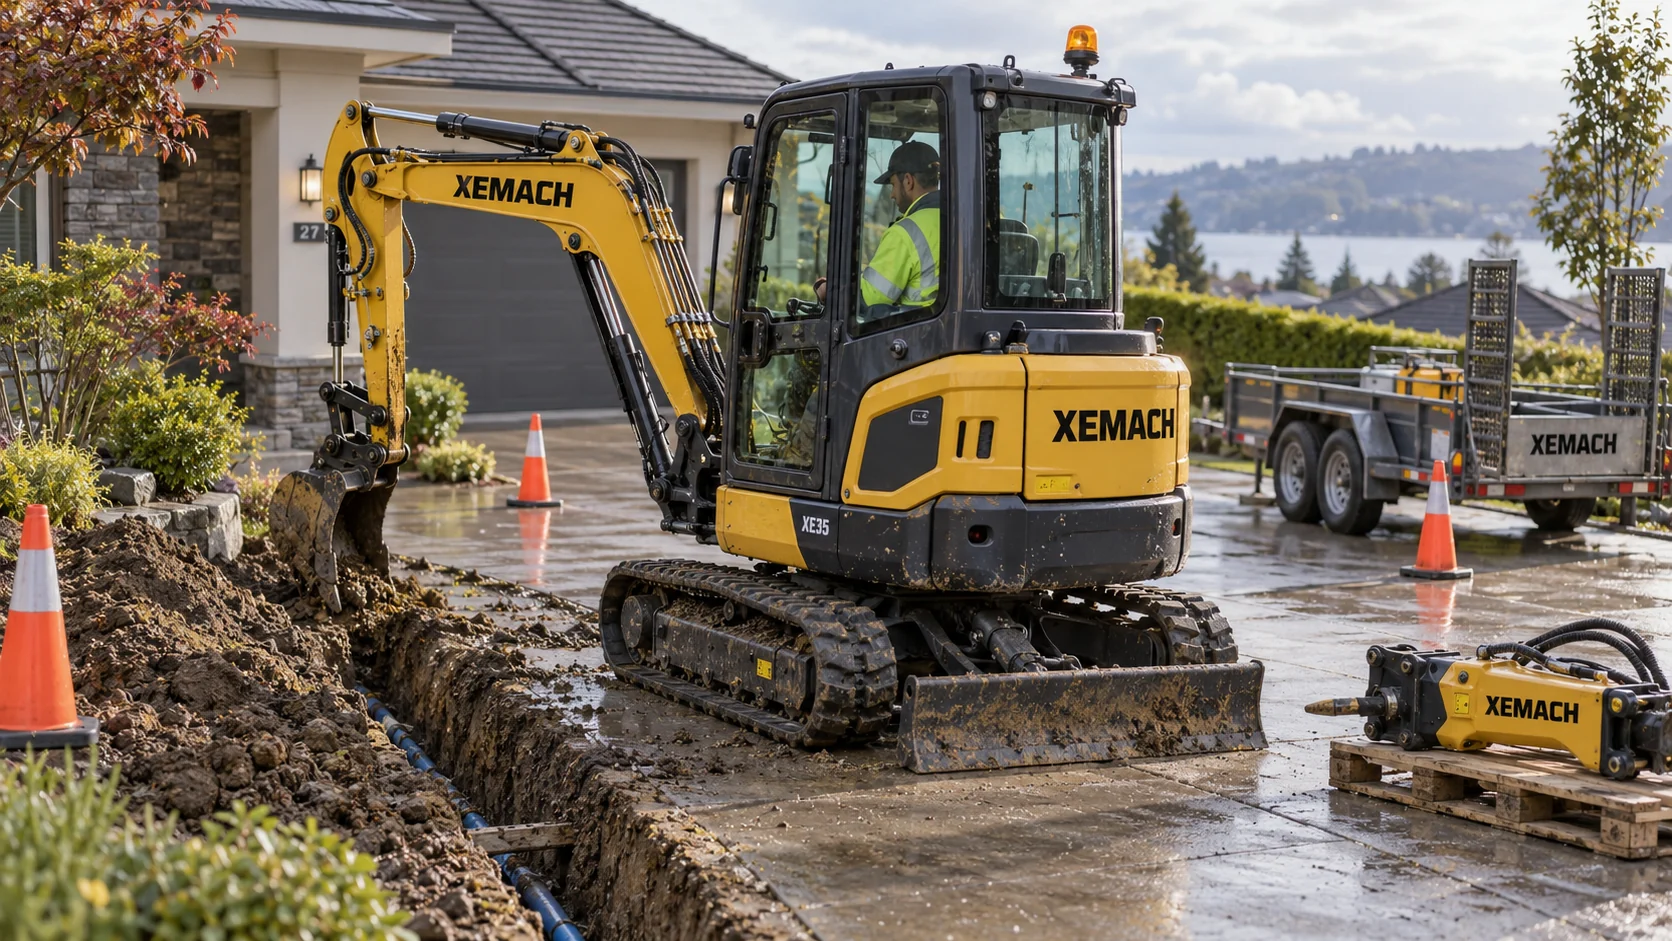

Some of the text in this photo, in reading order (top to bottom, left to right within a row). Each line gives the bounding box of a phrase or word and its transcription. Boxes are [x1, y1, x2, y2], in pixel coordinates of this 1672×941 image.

[453, 174, 575, 208] XEMACH
[300, 225, 319, 240] 27
[1051, 408, 1175, 443] XEMACH
[1530, 432, 1618, 456] XEMACH
[801, 515, 830, 536] XE35
[1485, 695, 1579, 724] XEMACH
